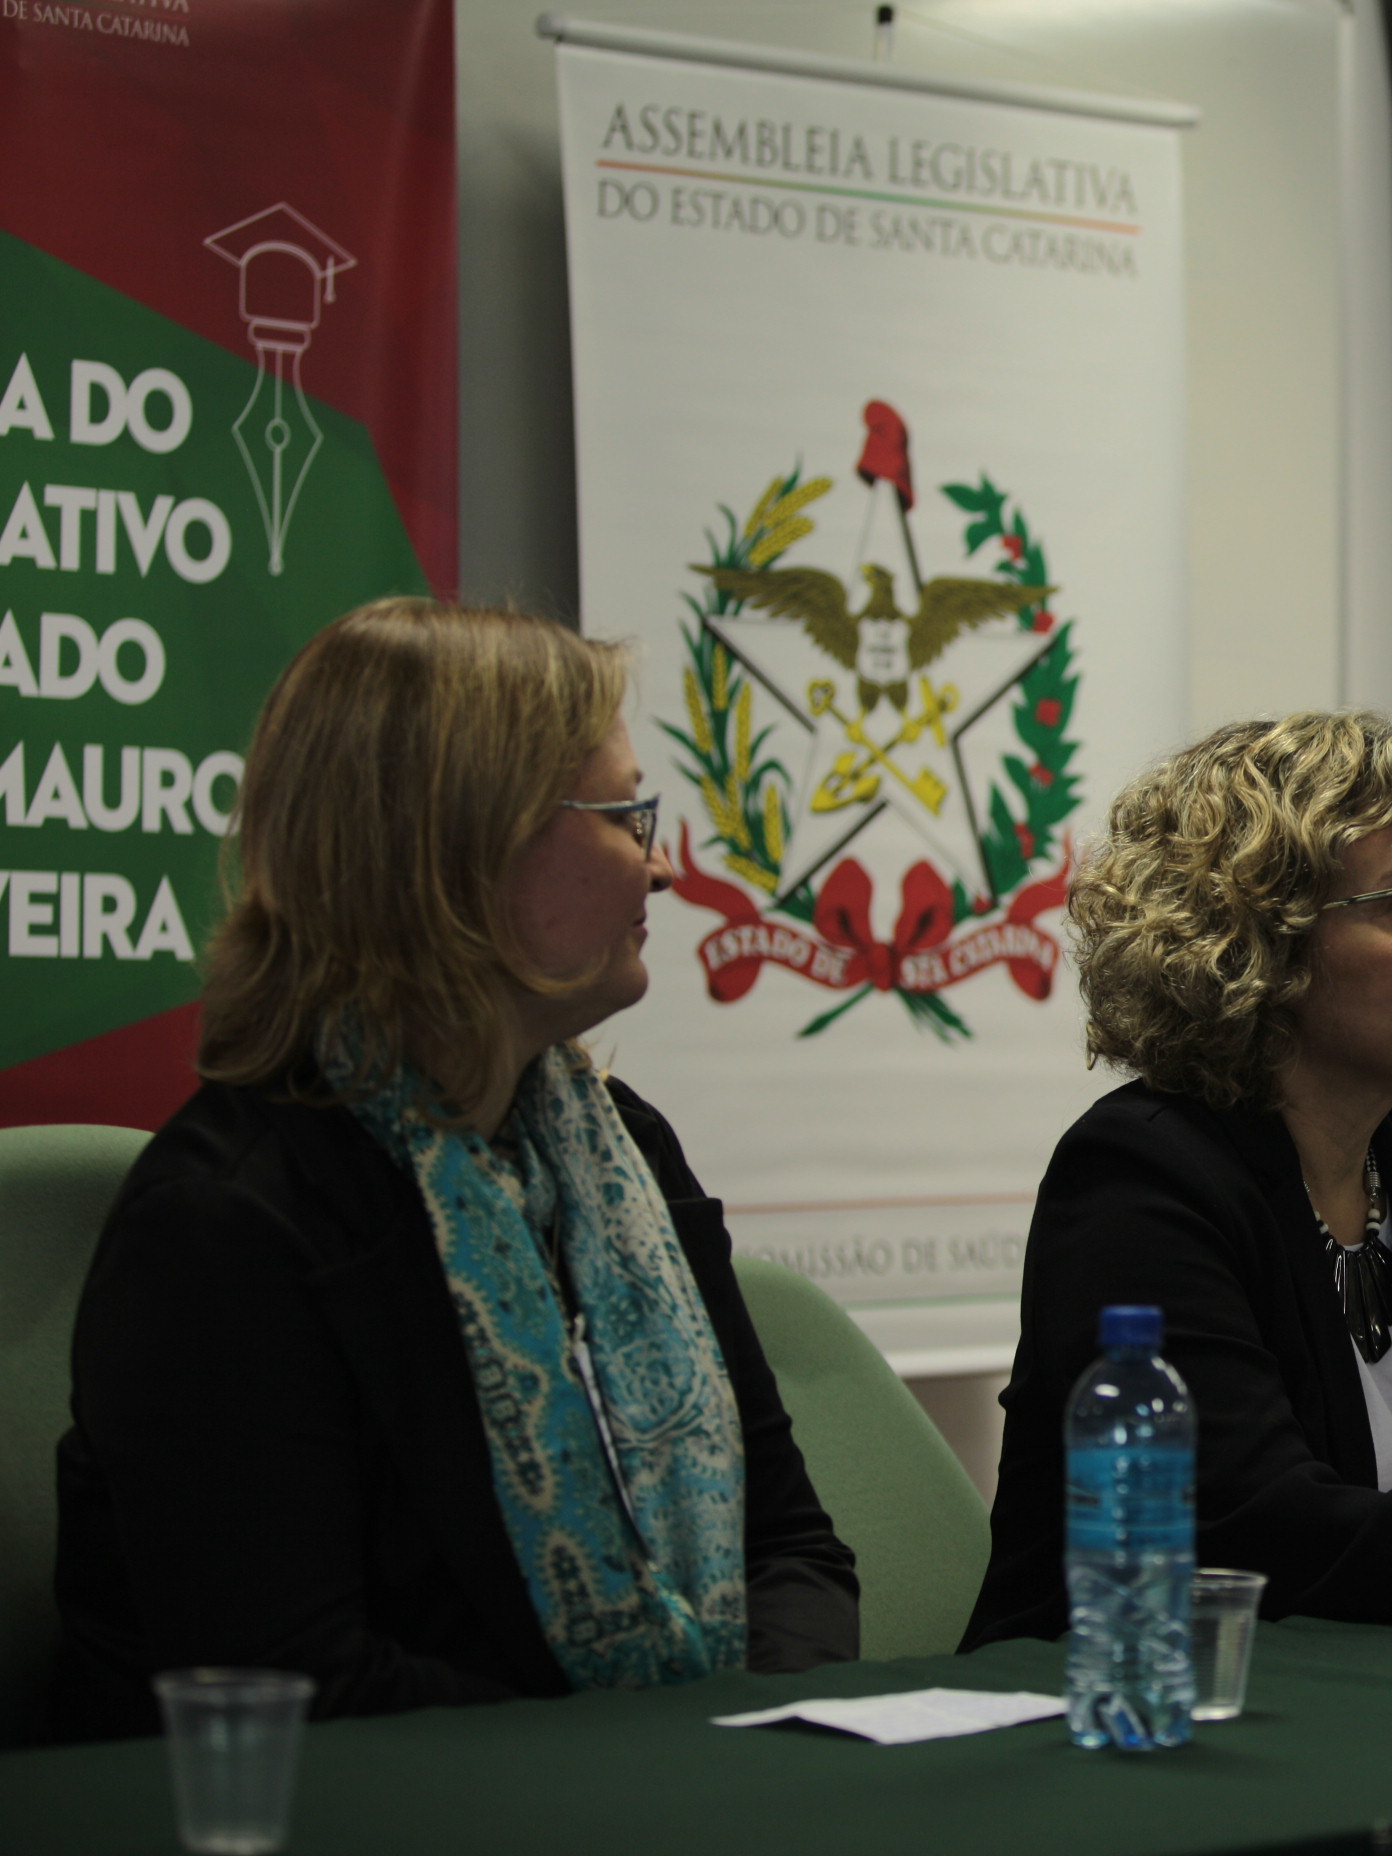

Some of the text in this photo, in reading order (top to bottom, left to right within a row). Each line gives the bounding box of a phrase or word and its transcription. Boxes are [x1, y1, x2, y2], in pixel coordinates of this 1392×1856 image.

[2, 0, 28, 20] DE
[33, 2, 93, 31] SANTA
[96, 13, 190, 47] CATARINA
[602, 103, 1138, 217] ASSEMBLEIA LEGISLATIVA
[596, 179, 1140, 281] DO ESTADO DE SANTA CATARINA
[70, 359, 193, 454] DO
[0, 481, 232, 584] ATIVO
[0, 608, 166, 705] ADO
[0, 871, 195, 962] EIRA
[704, 925, 810, 971] ESTADO
[811, 948, 847, 986] DE
[902, 1236, 939, 1274] DE
